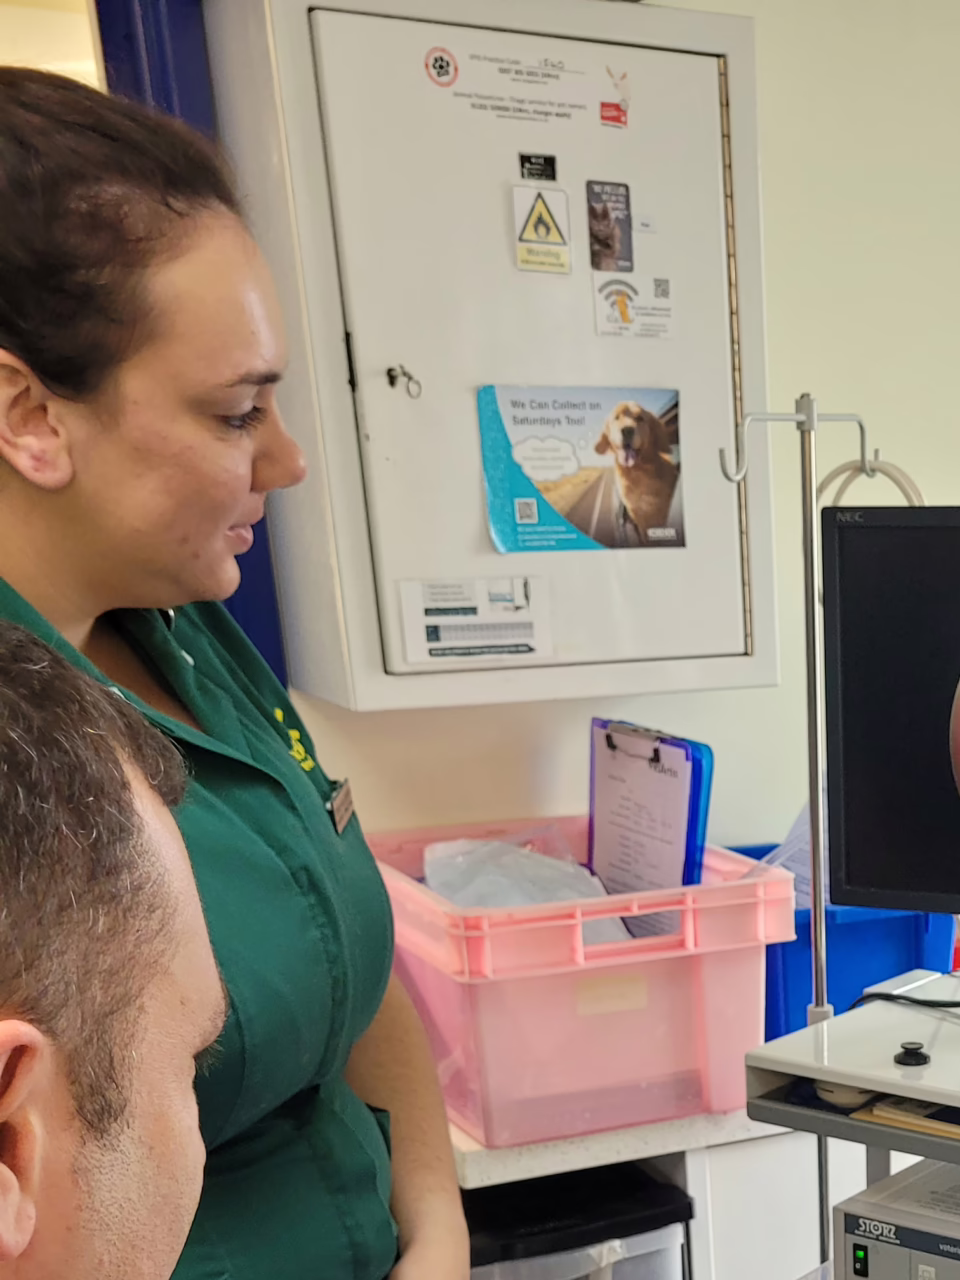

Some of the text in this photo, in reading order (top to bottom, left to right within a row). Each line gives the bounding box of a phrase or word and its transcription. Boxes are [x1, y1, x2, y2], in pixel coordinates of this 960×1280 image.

[509, 399, 602, 411] We Can Collect on
[512, 415, 586, 429] Saturdays Too!
[836, 511, 864, 522] NEC
[857, 1217, 897, 1240] STORZ
